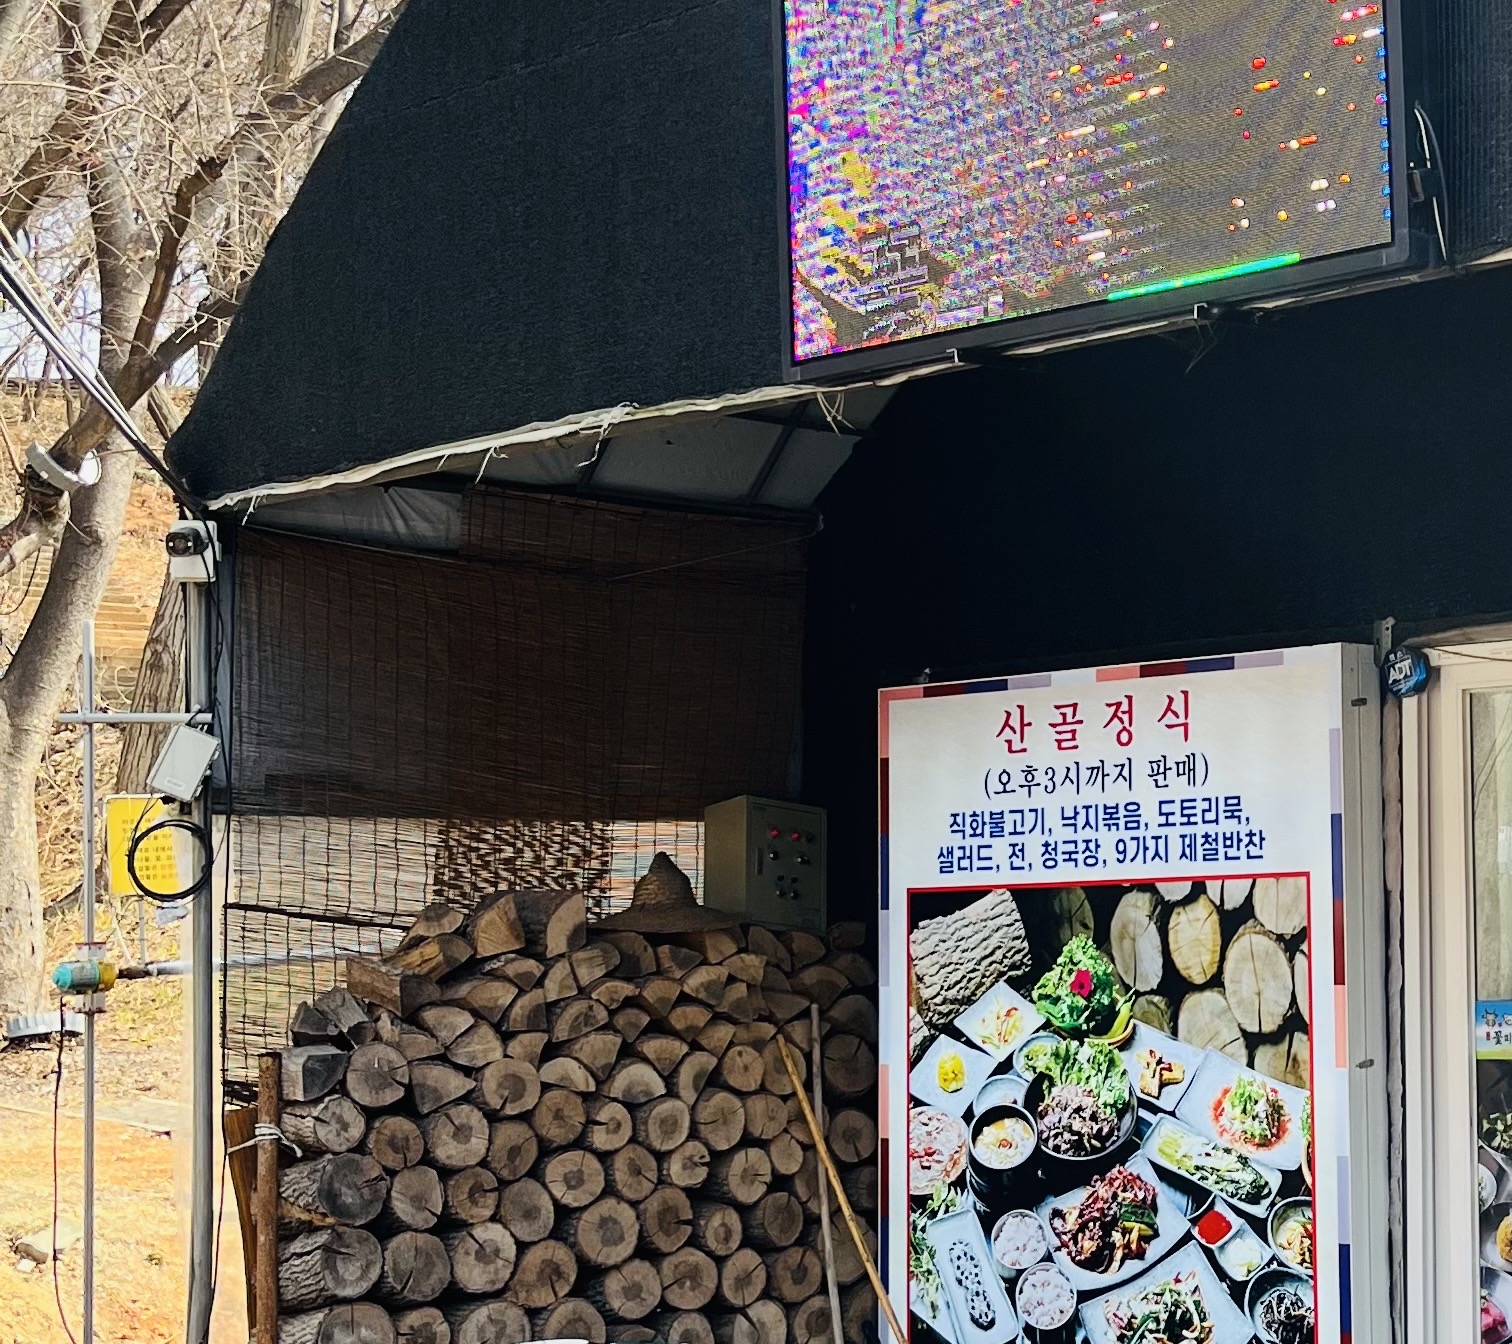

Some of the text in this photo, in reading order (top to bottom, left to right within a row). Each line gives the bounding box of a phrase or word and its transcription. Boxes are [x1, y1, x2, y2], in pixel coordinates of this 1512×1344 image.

[1389, 659, 1411, 684] ADT
[984, 752, 1209, 800] (오후3시까지 판매)
[950, 795, 1250, 840] 직화불고기, 낙지볶음, 도토리묵,
[937, 829, 1266, 874] 샐러드, 전, 청국장, 9가지 제철반찬
